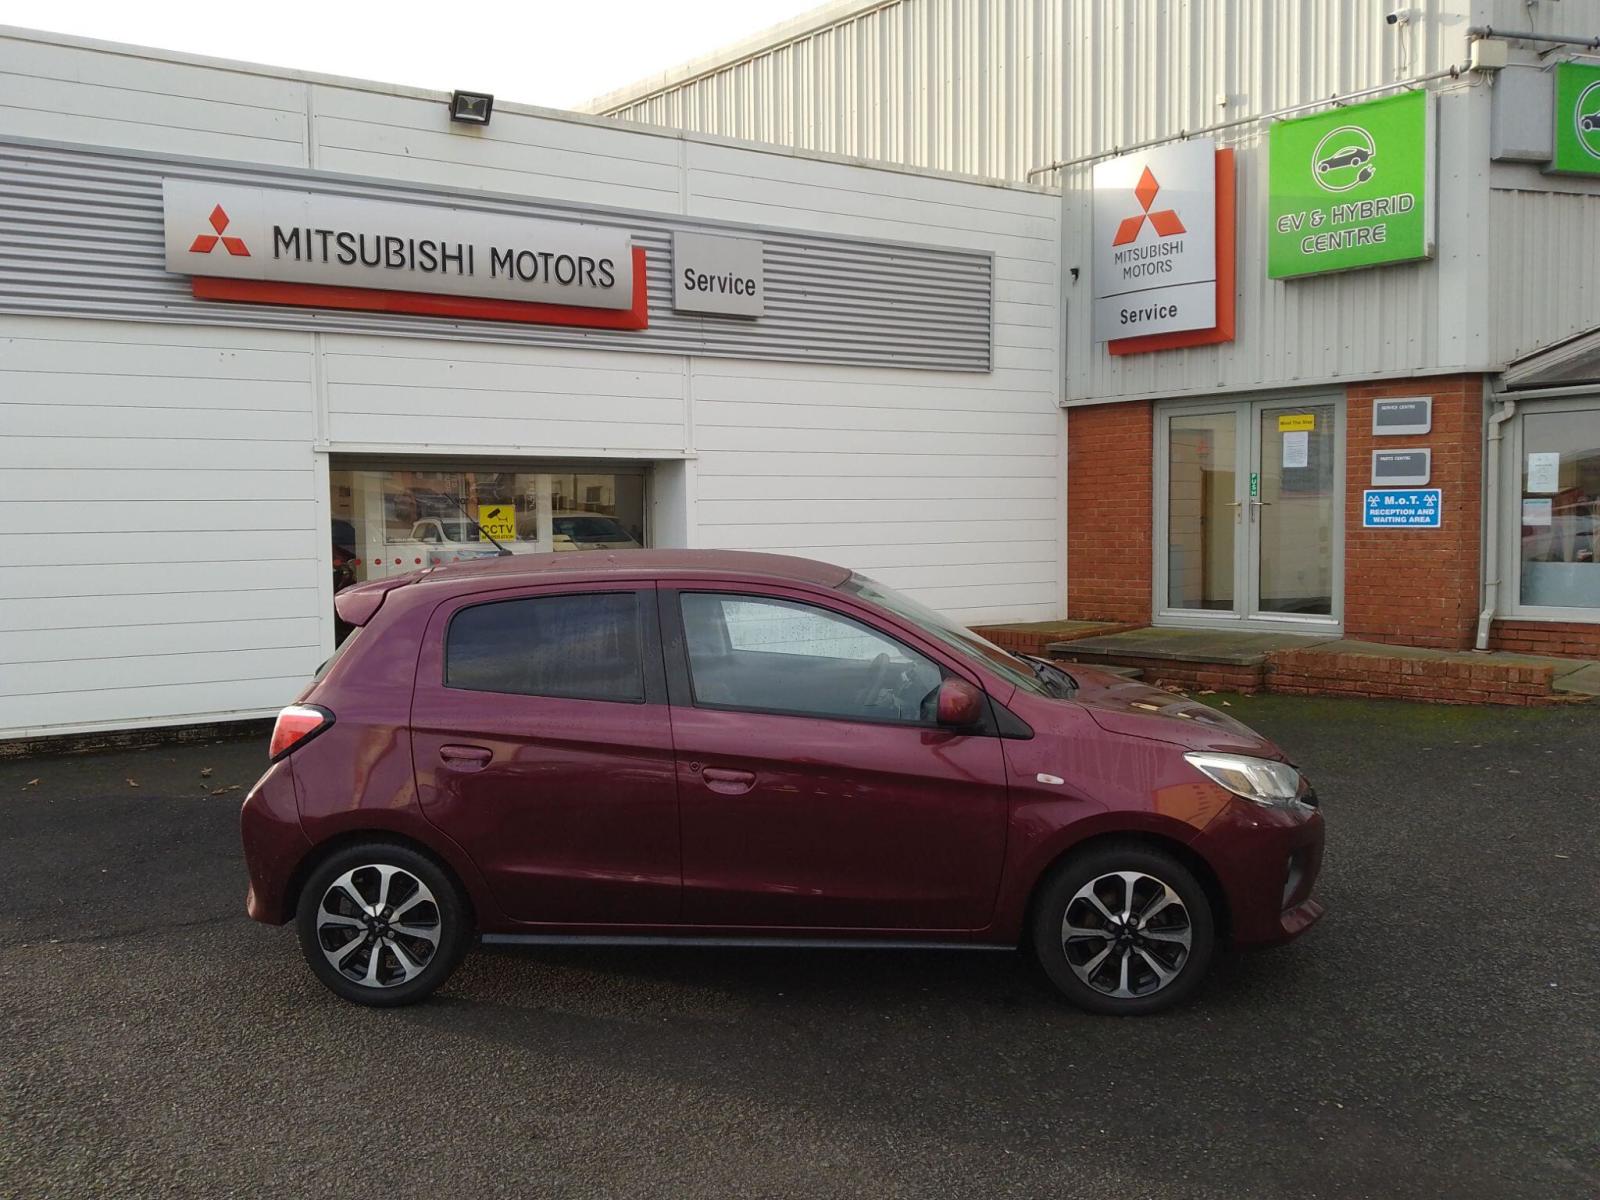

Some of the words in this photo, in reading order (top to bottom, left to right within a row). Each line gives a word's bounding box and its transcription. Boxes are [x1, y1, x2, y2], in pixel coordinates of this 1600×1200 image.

[1277, 212, 1305, 233] EV
[1310, 209, 1326, 228] &
[1331, 193, 1415, 225] HYBRID
[1301, 223, 1386, 254] CENTRE
[273, 225, 474, 275] MITSUBISHI
[490, 247, 615, 288] MOTORS
[1114, 240, 1184, 265] MITSUBISHI
[1123, 259, 1173, 280] MOTORS
[684, 268, 756, 296] Service
[1120, 304, 1178, 324] Service
[1384, 495, 1420, 505] M.o.T.
[1369, 508, 1415, 516] RECEPTION
[482, 524, 513, 534] CCTV
